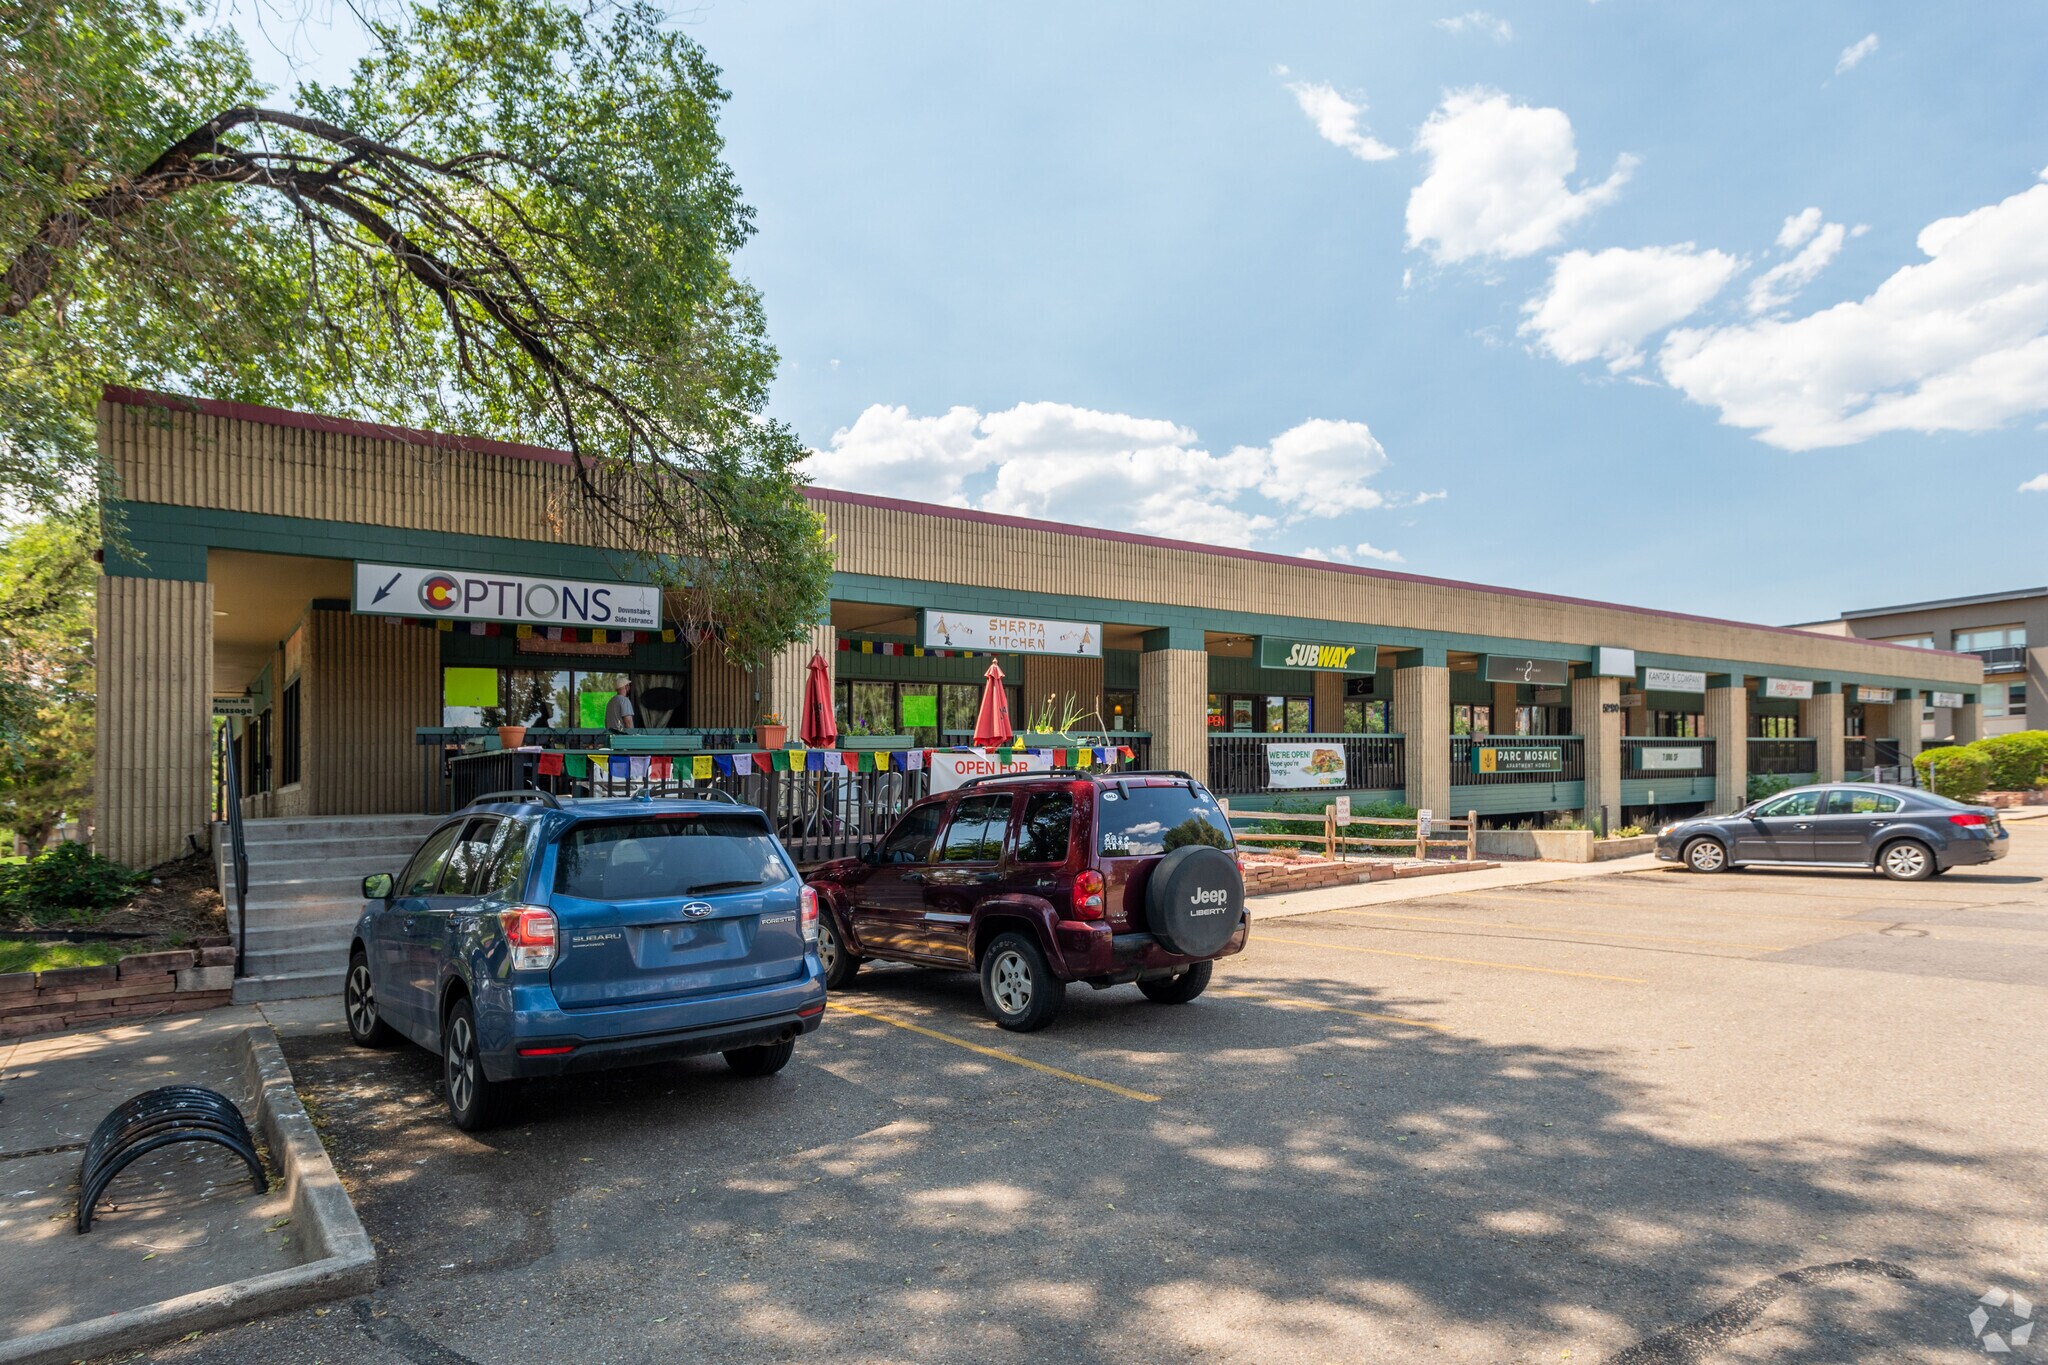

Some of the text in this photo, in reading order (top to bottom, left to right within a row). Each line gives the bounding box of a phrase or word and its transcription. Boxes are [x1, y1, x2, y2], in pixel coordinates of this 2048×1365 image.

[418, 571, 611, 622] OPTIONS
[617, 606, 651, 616] Downstairs
[628, 616, 654, 625] Entrance
[988, 618, 1045, 637] SHERPA
[988, 636, 1045, 651] KITCHEN
[1285, 643, 1356, 668] SUBWAY
[1647, 672, 1670, 681] KANTOR
[1207, 715, 1225, 727] PEN
[1269, 750, 1311, 759] WE'RE OPEN!
[1497, 750, 1558, 761] PARC MOSAIC
[955, 760, 1029, 775] OPEN FOR
[1283, 760, 1299, 768] you're
[1190, 887, 1227, 906] Jeep
[1190, 908, 1227, 916] LIBERTY
[761, 916, 796, 925] FORESTER
[572, 933, 621, 942] SUBARU
